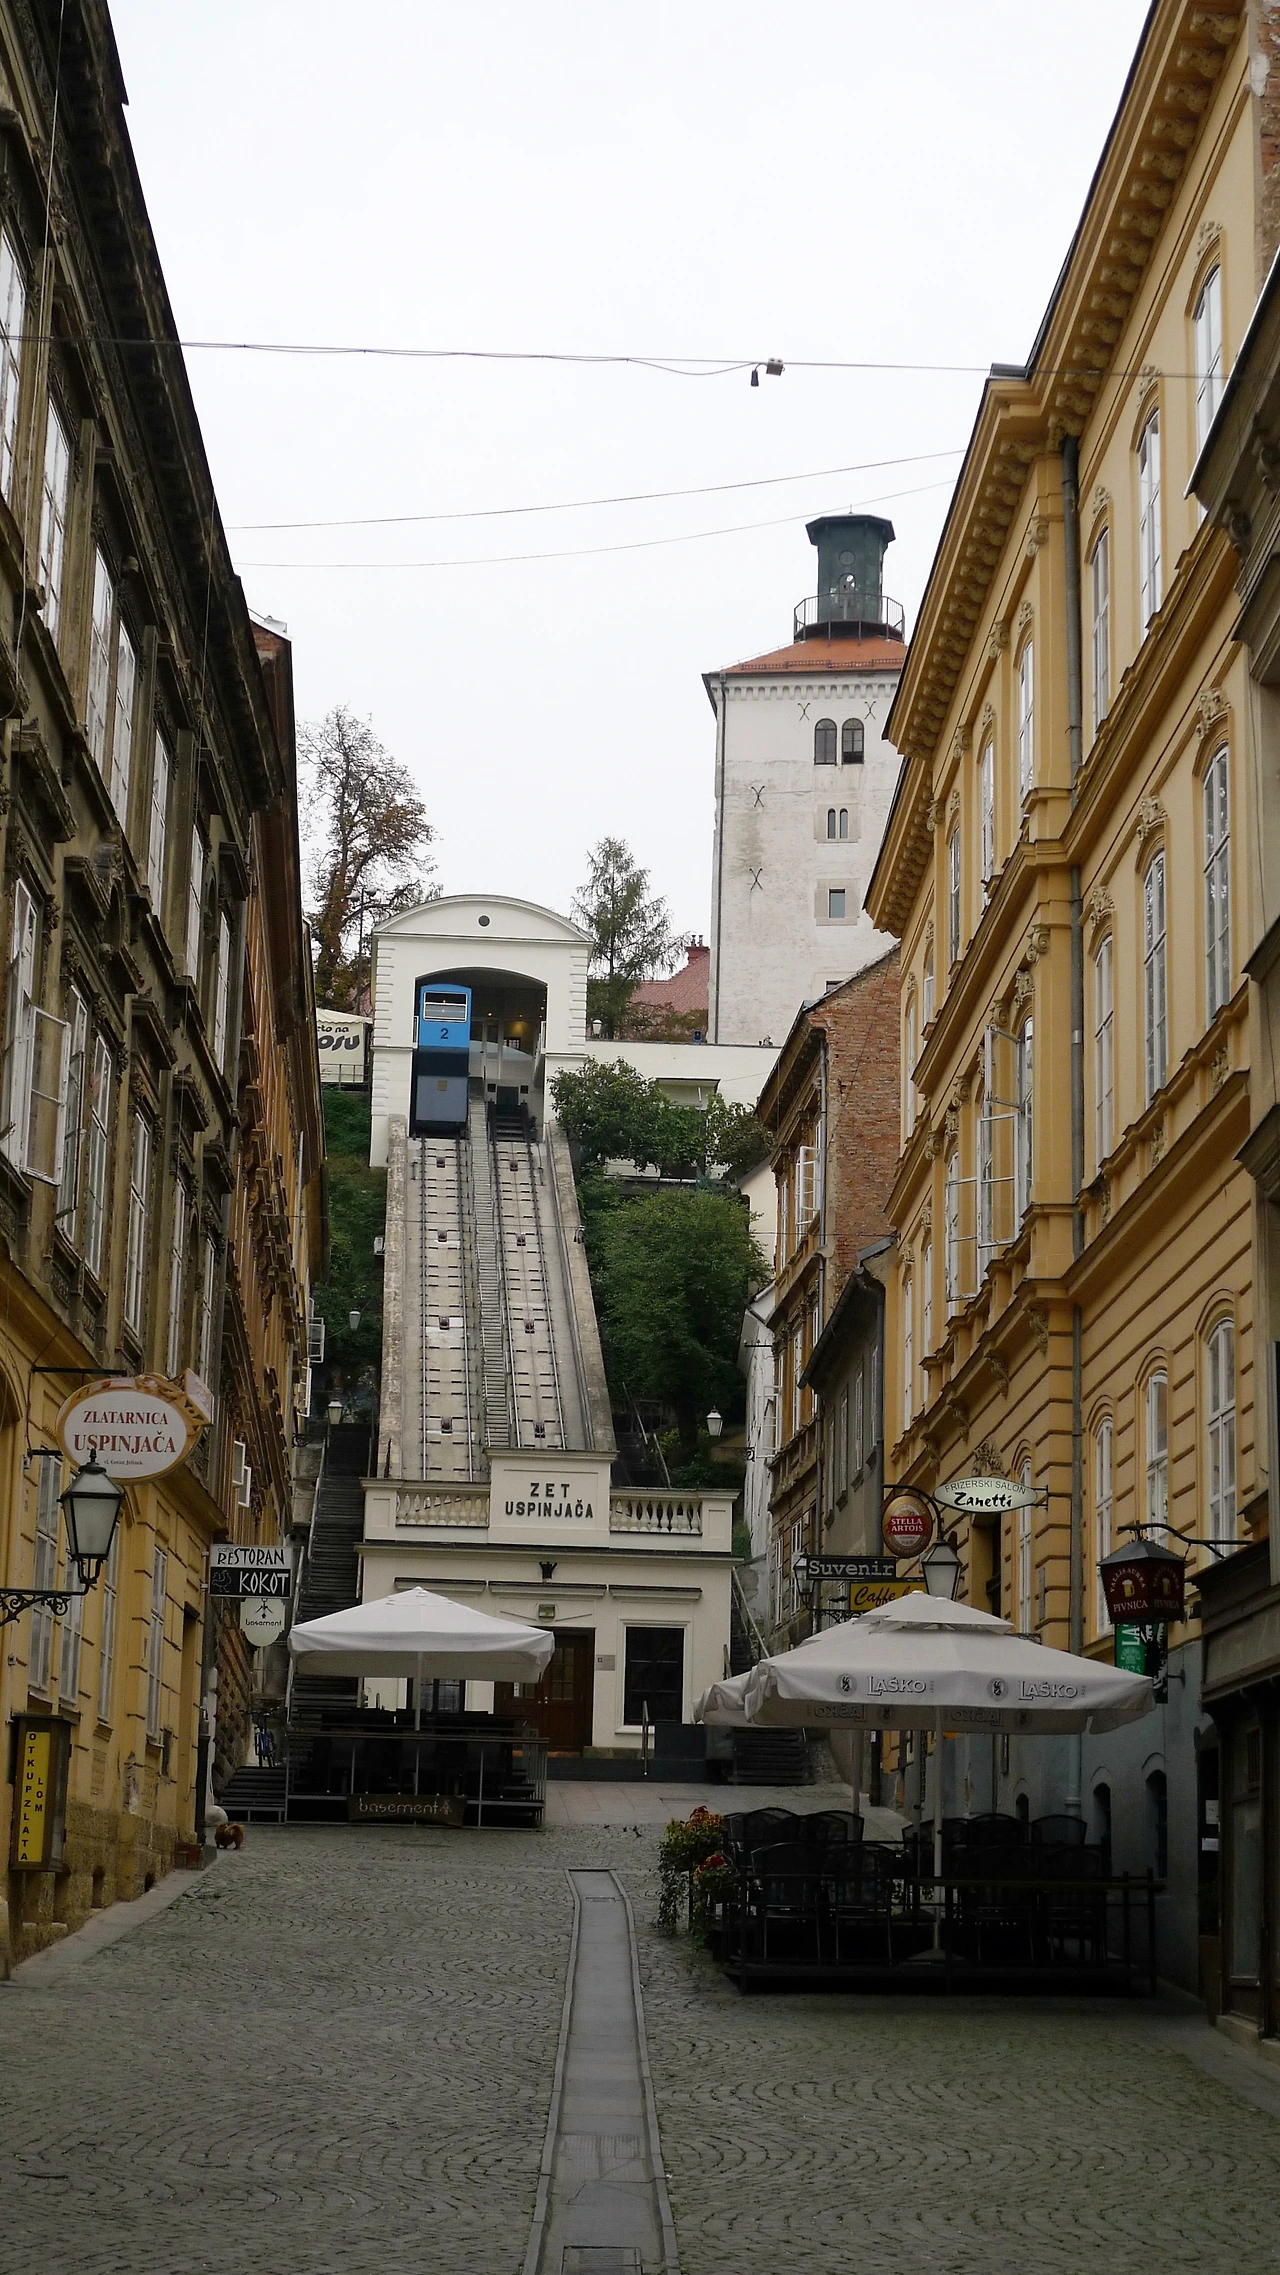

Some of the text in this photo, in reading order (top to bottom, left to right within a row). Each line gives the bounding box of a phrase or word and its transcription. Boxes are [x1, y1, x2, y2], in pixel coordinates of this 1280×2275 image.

[440, 1027, 449, 1040] 2
[83, 1410, 169, 1425] ZLATARNICA
[73, 1430, 176, 1454] USPINJAČA
[530, 1482, 570, 1498] ZET
[944, 1480, 1026, 1495] FRIZERSKI SALON
[953, 1491, 1012, 1508] Zanetti
[505, 1499, 594, 1518] USPINJAČA
[217, 1547, 285, 1566] RESTORAN
[808, 1560, 895, 1576] Suvenir
[239, 1570, 289, 1596] KOKOT
[854, 1585, 896, 1607] Caffe
[1113, 1599, 1149, 1613] PIVNICA
[245, 1618, 282, 1627] basement
[34, 1777, 44, 1813] LOM
[359, 1797, 439, 1814] basement
